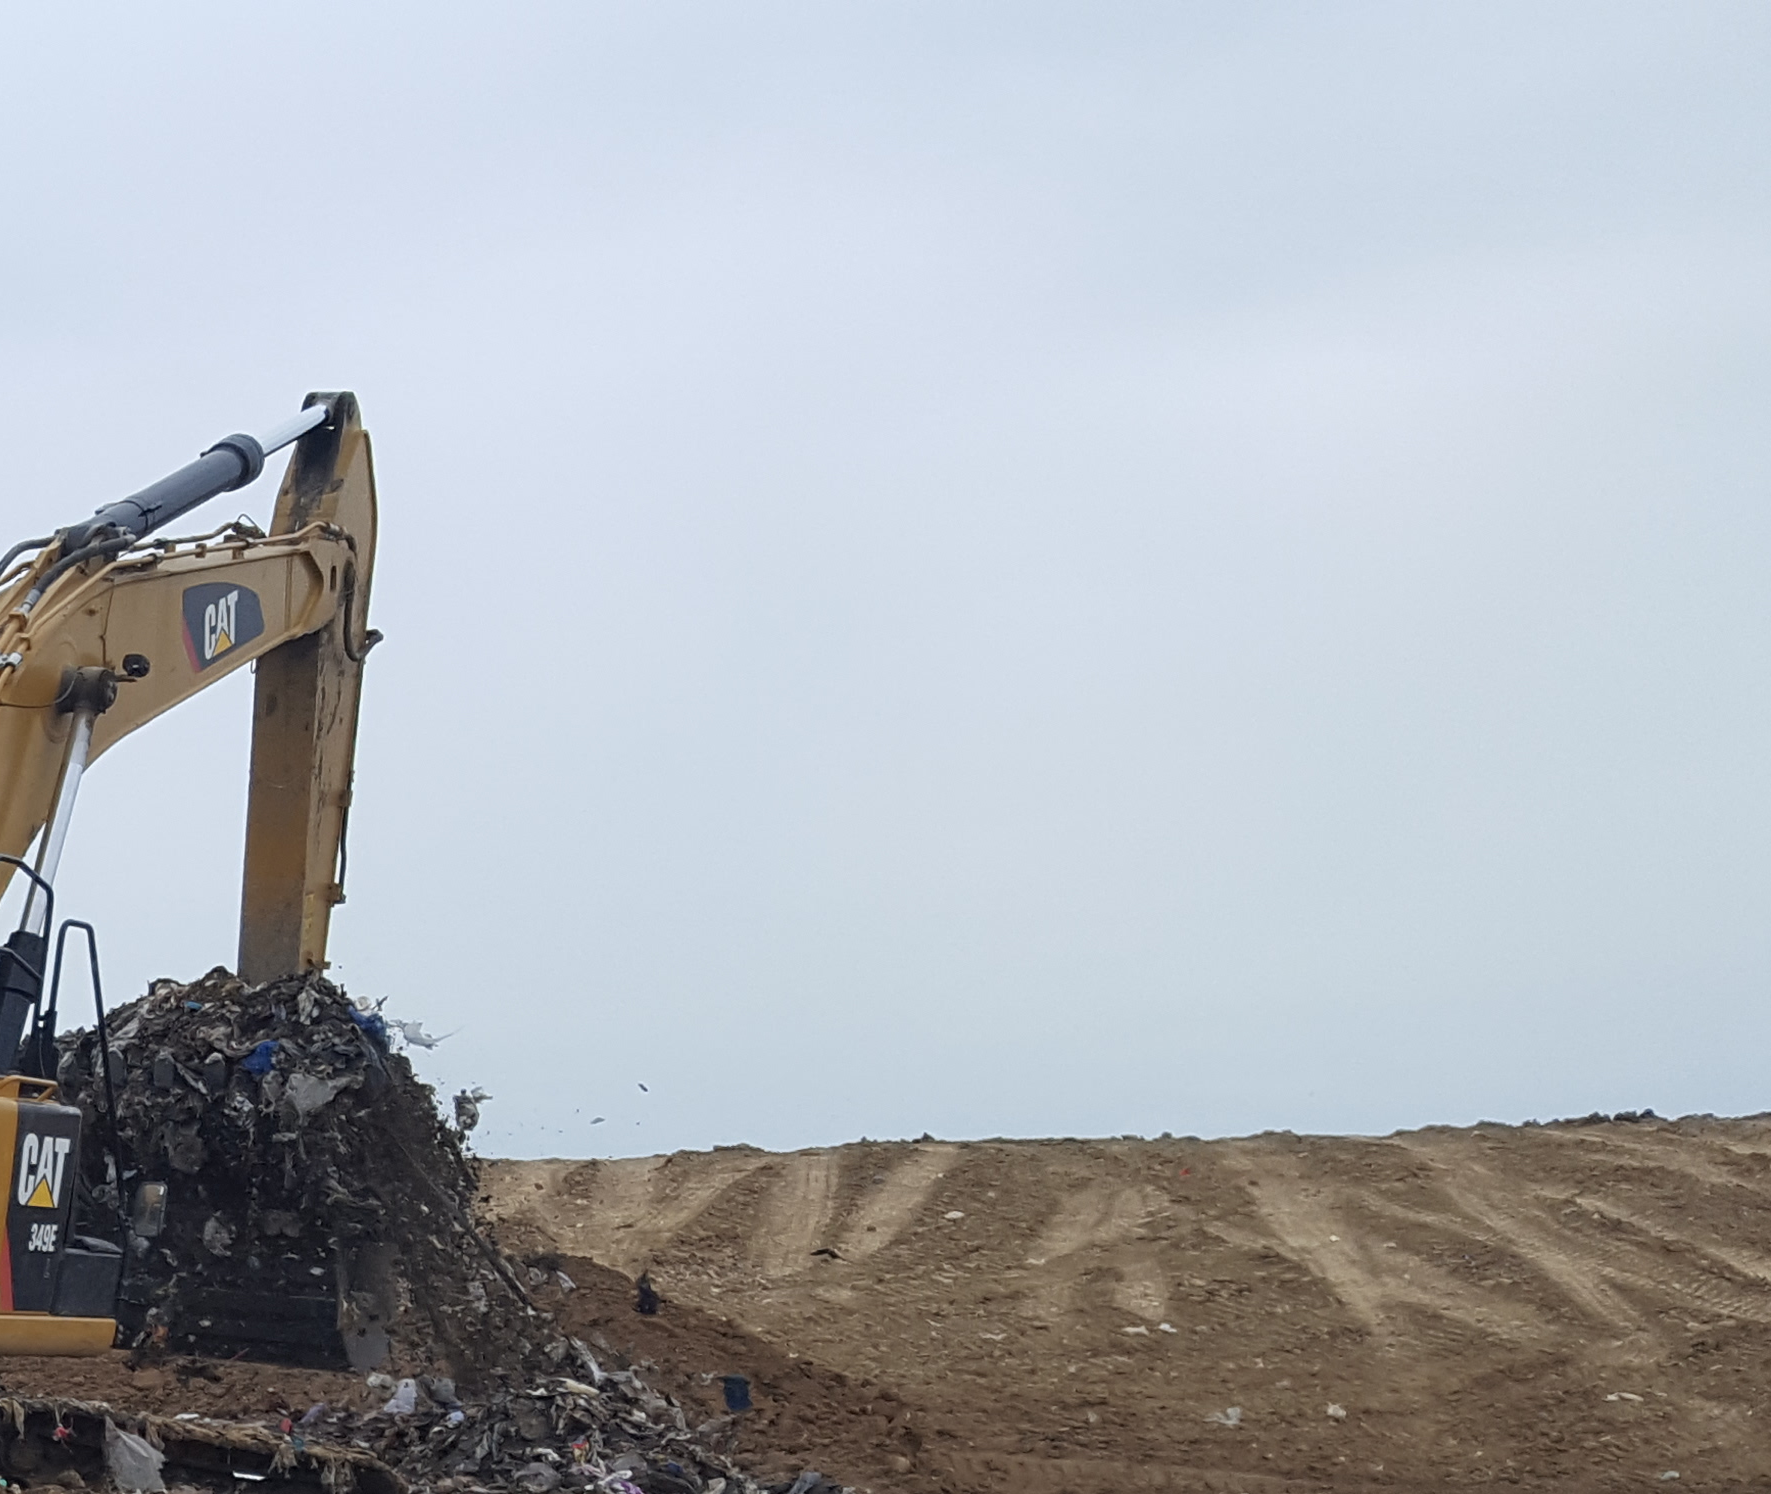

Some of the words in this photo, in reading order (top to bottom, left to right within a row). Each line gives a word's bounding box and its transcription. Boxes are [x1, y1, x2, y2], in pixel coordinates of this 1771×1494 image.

[204, 590, 238, 660] CAT
[18, 1133, 71, 1208] CAT
[28, 1223, 59, 1252] 349E
